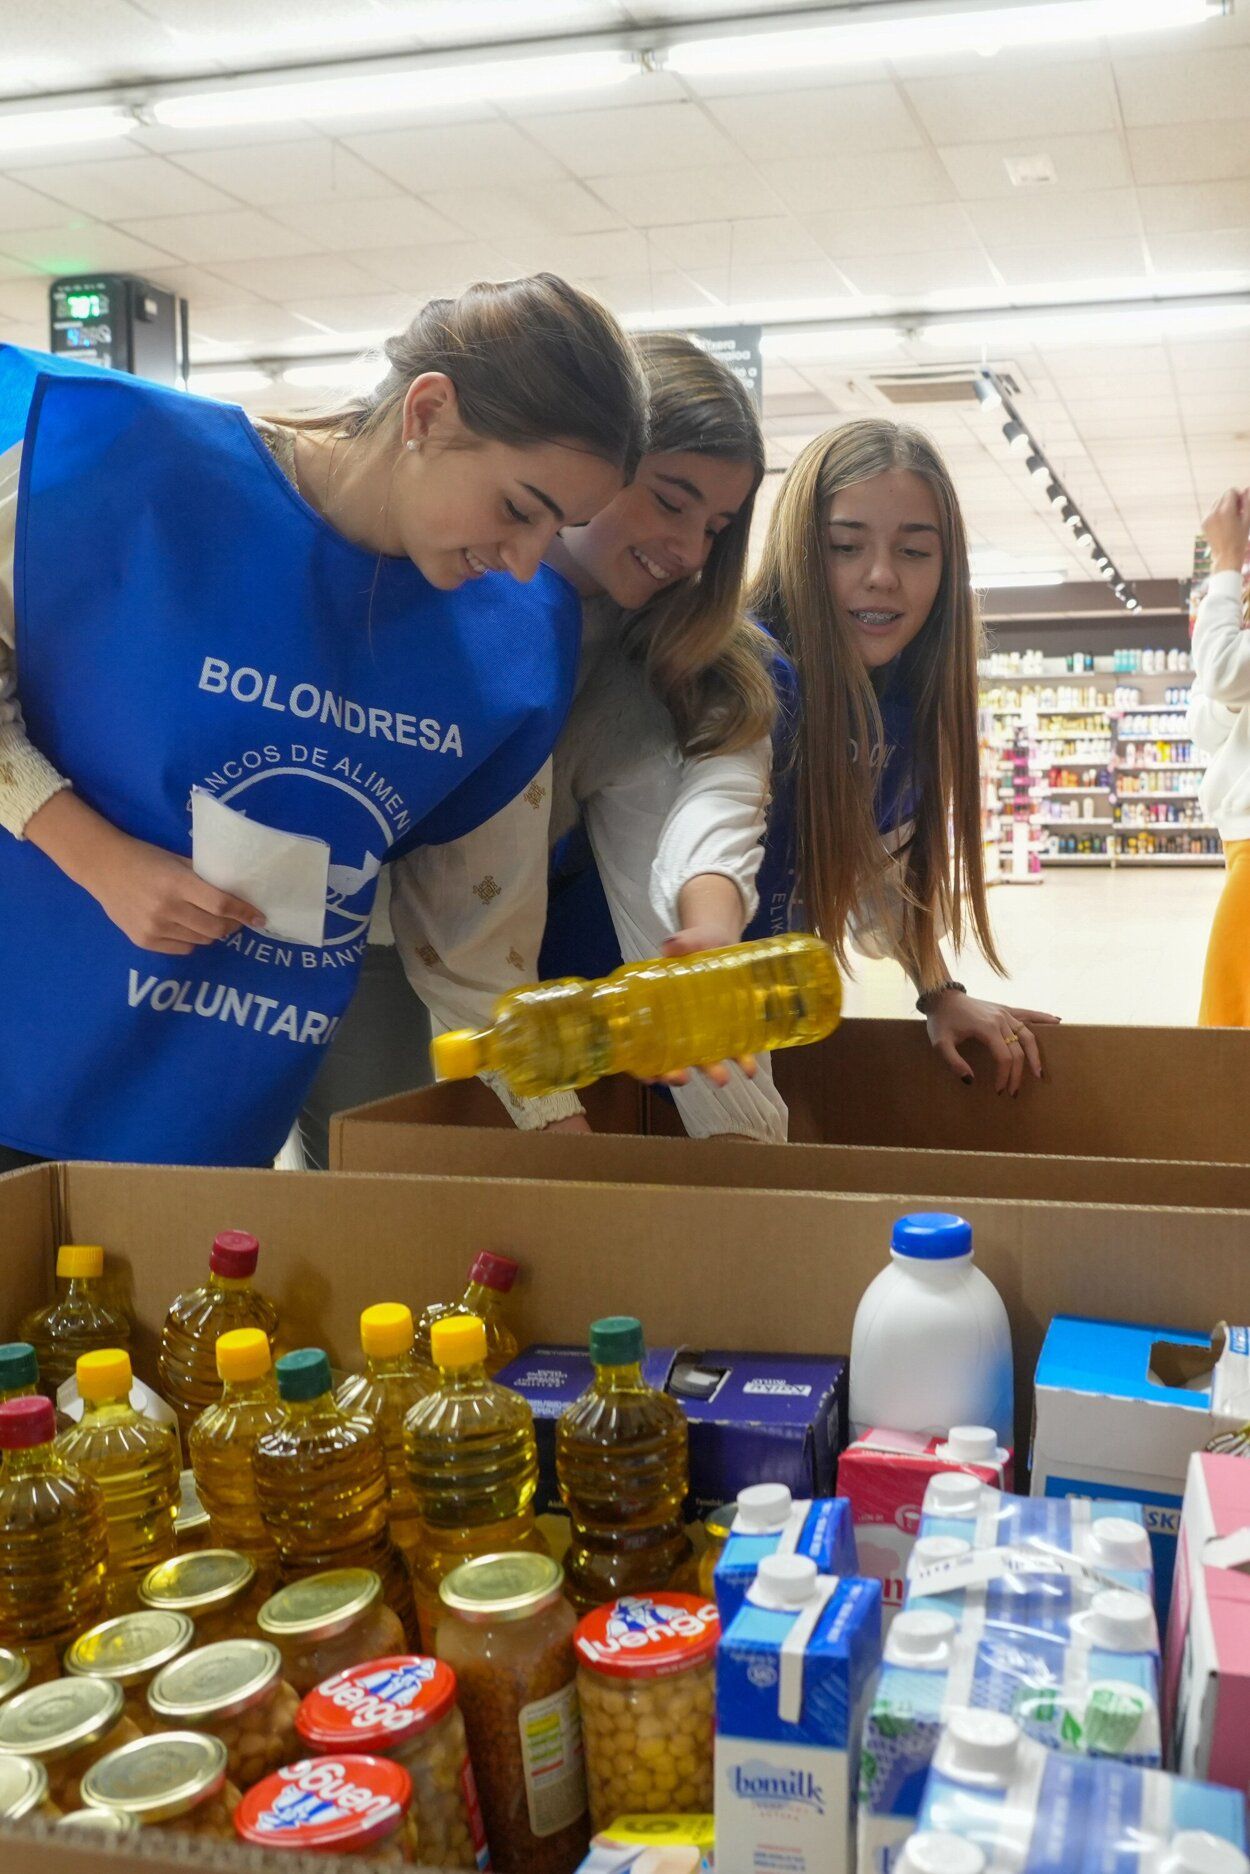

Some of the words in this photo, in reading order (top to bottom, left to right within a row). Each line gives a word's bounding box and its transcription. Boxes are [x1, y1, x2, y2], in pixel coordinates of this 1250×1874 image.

[198, 656, 463, 758] BOLONDRESA
[291, 744, 328, 768] DE
[218, 933, 293, 968] AIEN
[127, 968, 342, 1045] VOLUNTARI
[317, 1674, 416, 1730] uengo
[734, 1765, 827, 1806] bomilk
